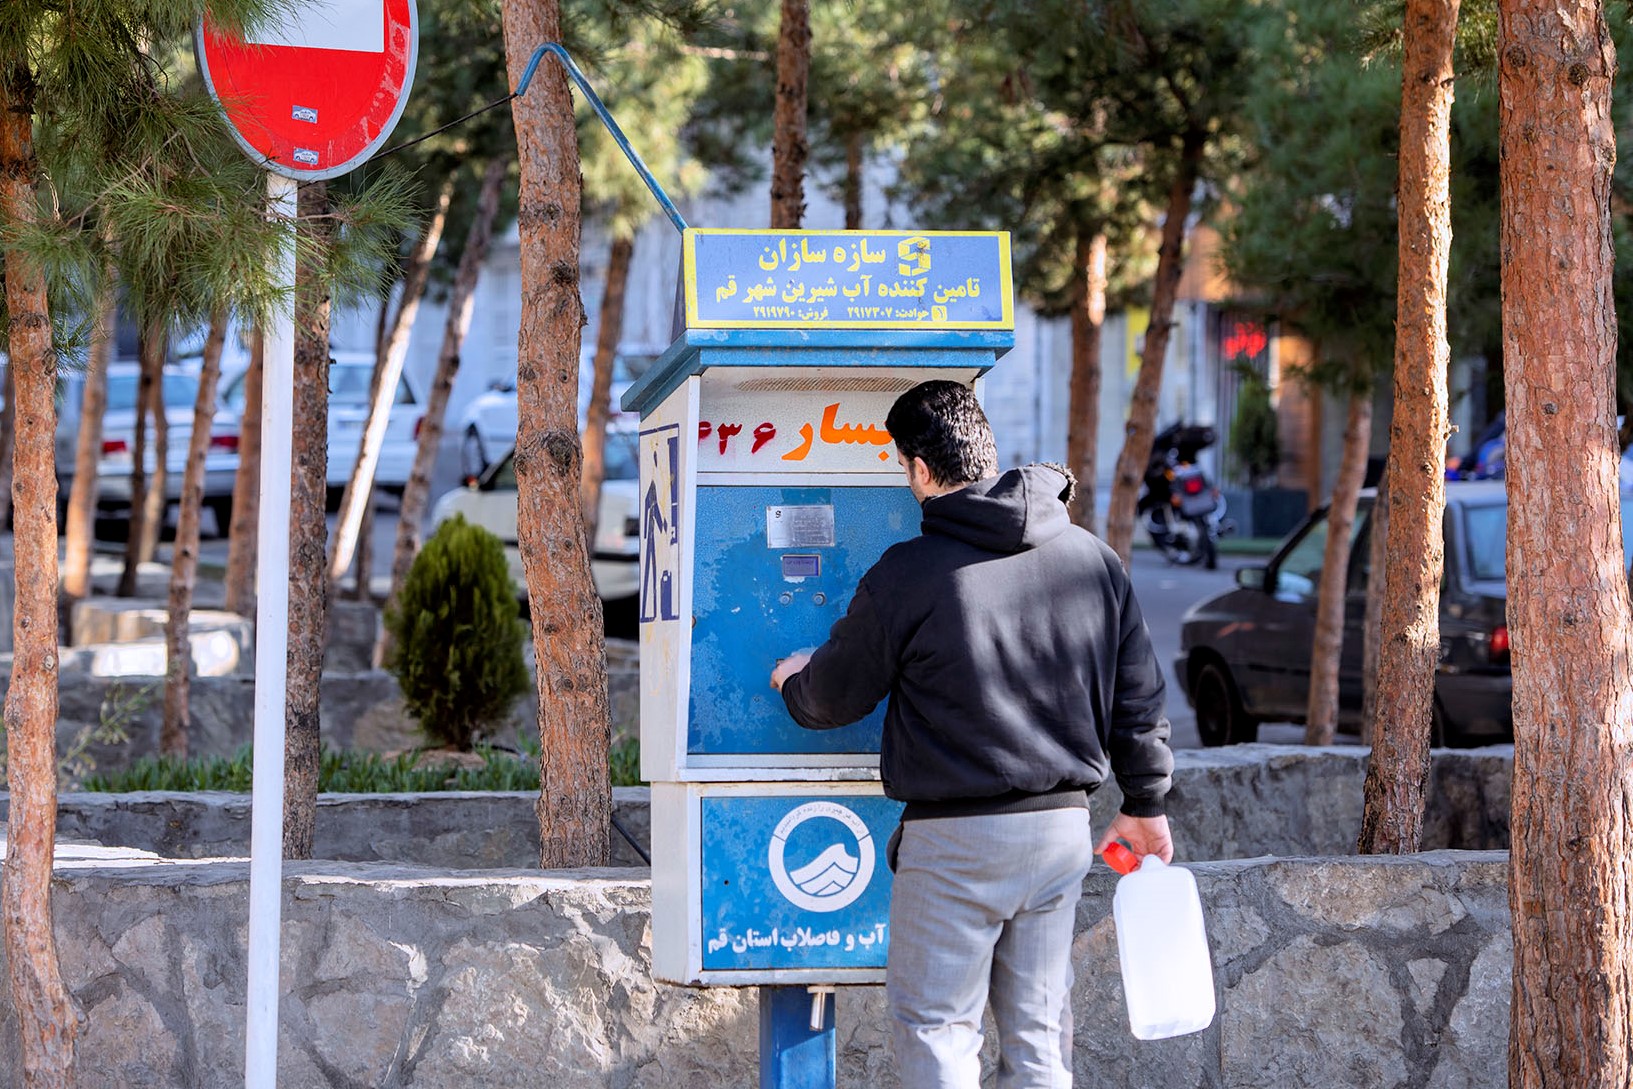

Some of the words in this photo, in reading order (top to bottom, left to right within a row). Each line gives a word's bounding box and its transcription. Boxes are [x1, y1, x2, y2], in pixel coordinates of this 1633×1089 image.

[758, 238, 827, 272] سازان
[833, 238, 886, 272] سازه
[715, 275, 737, 303] قم
[742, 277, 777, 303] شهر
[781, 277, 838, 304] شیرین
[842, 274, 872, 302] آب
[877, 276, 928, 298] کننده
[933, 277, 981, 303] تامین
[753, 306, 795, 318] ۲۹۱۹۷۹۰
[847, 307, 893, 319] ۲۹۱۷۳۰۷
[708, 926, 729, 954] قم
[731, 927, 778, 953] استان
[844, 933, 856, 952] و
[858, 922, 887, 951] آب
